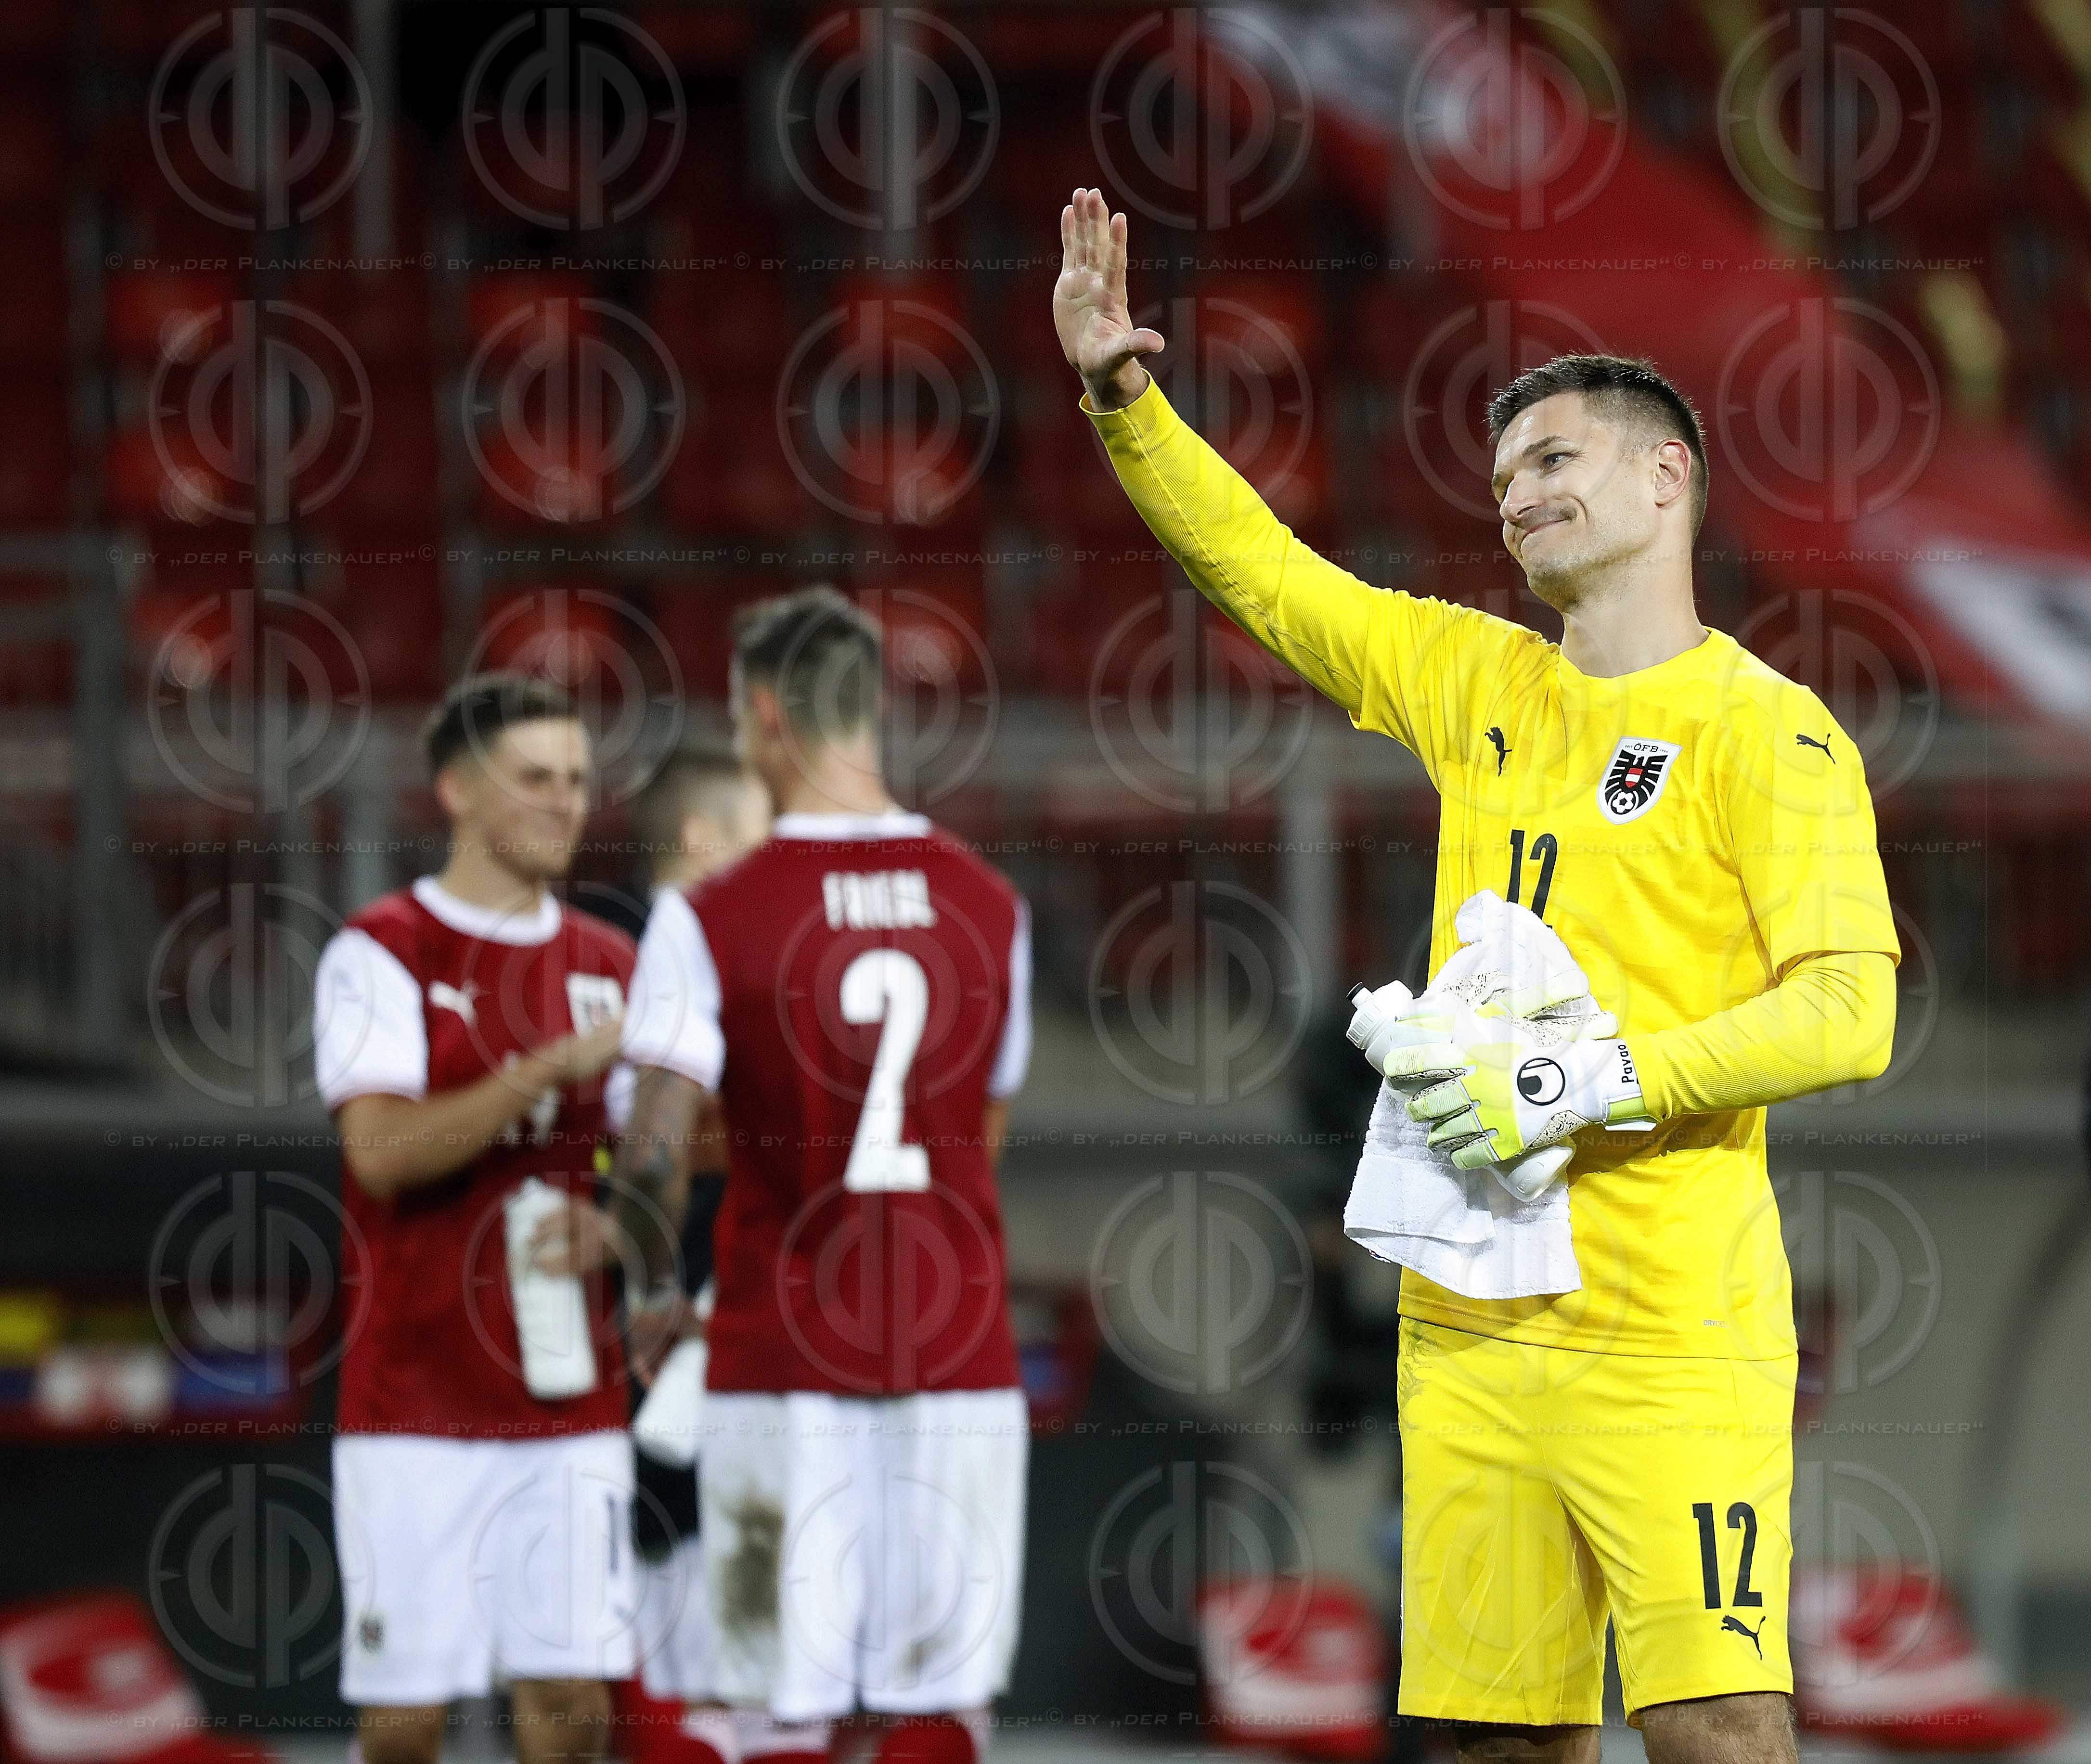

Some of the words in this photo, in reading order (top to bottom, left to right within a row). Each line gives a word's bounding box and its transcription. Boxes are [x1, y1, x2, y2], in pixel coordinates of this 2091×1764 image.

[1634, 743, 1659, 752] ÖFB
[1507, 829, 1558, 929] 12
[840, 947, 930, 1193] 2
[1618, 1044, 1634, 1083] Pavao
[1692, 1502, 1762, 1609] 12
